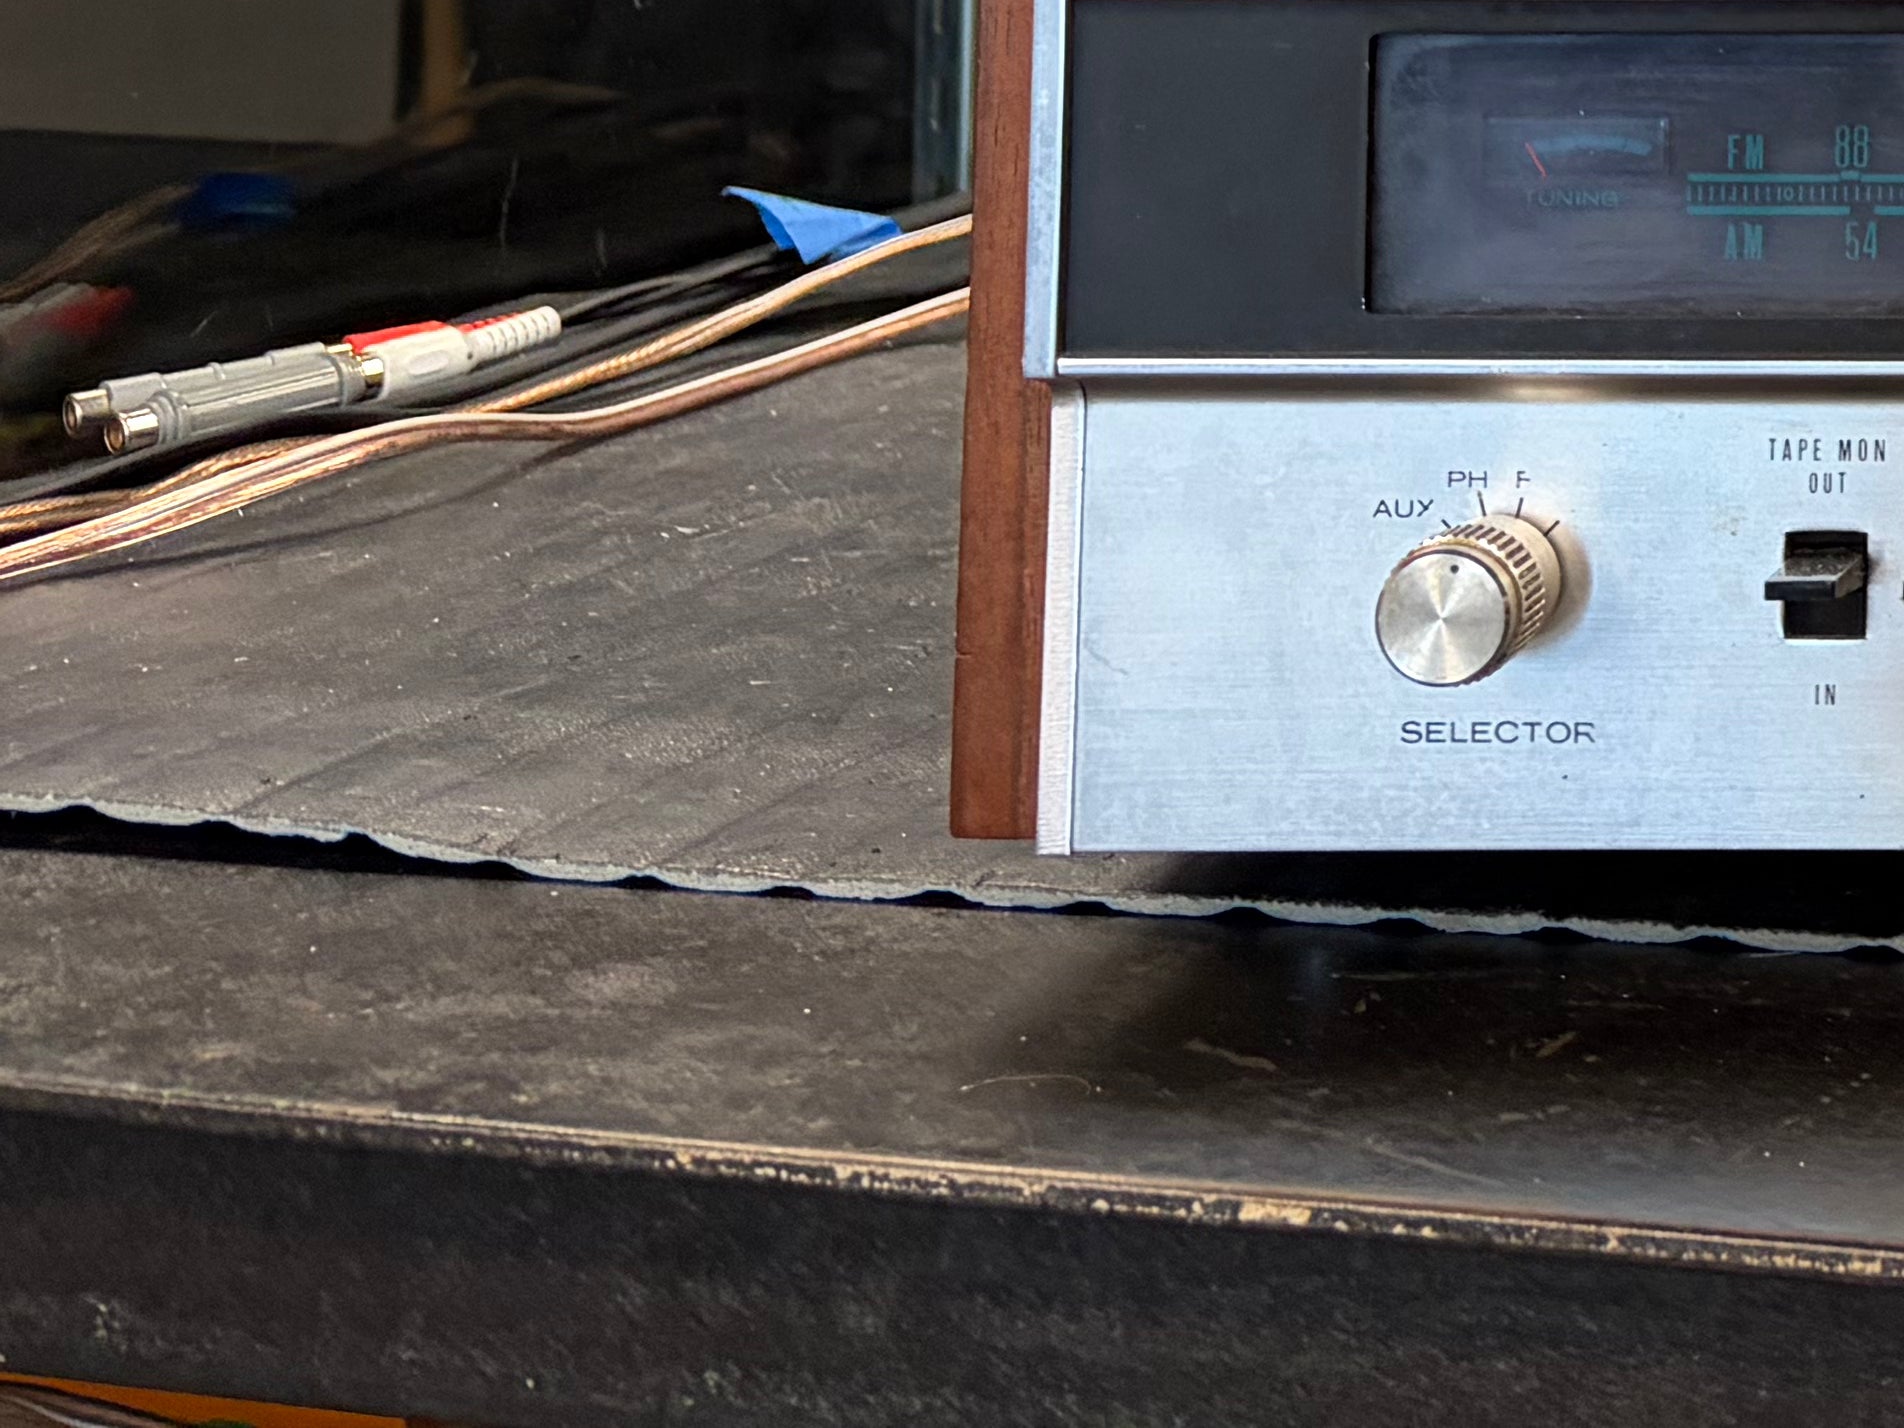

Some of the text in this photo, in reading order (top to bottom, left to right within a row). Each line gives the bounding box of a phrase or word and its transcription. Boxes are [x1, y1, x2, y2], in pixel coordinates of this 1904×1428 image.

[1727, 134, 1764, 170] FM
[1835, 124, 1870, 168] 88
[1525, 189, 1620, 209] TUNING
[1724, 223, 1764, 261] AM
[1845, 221, 1878, 262] 54
[1768, 439, 1887, 463] TAPE MON
[1372, 499, 1435, 519] AUX
[1447, 470, 1489, 489] PH
[1808, 472, 1848, 495] OUT
[1813, 684, 1836, 706] IN
[1401, 720, 1596, 744] SELECTOR
